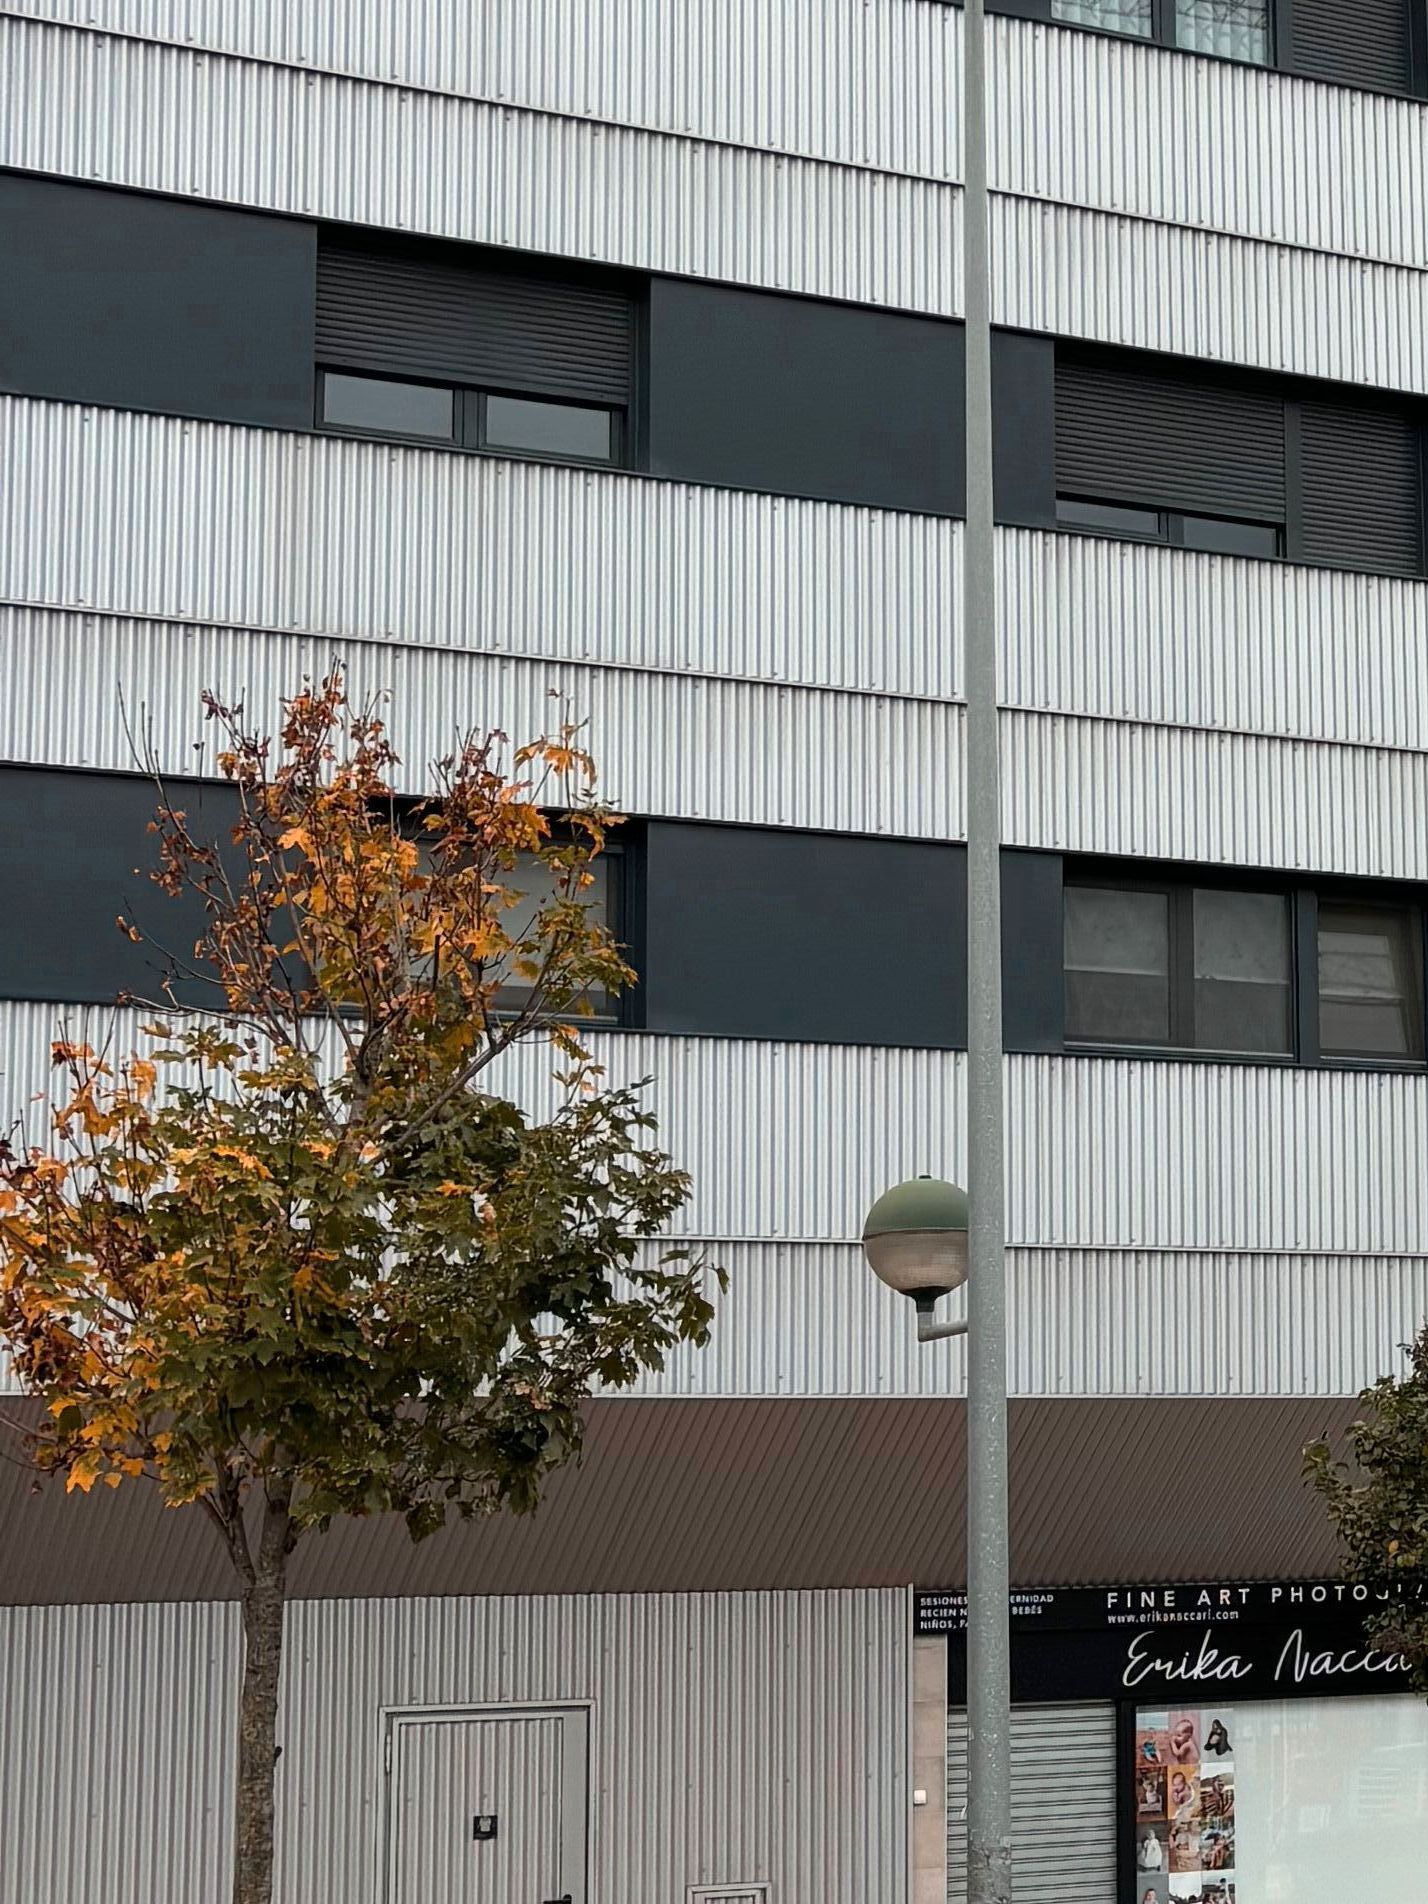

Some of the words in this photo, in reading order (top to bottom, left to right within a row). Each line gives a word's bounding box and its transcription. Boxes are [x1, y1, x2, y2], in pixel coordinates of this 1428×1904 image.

[1107, 1590, 1176, 1609] FINE
[1197, 1588, 1250, 1605] ART
[1122, 1629, 1253, 1686] Erika
[1274, 1628, 1413, 1683] Nacca
